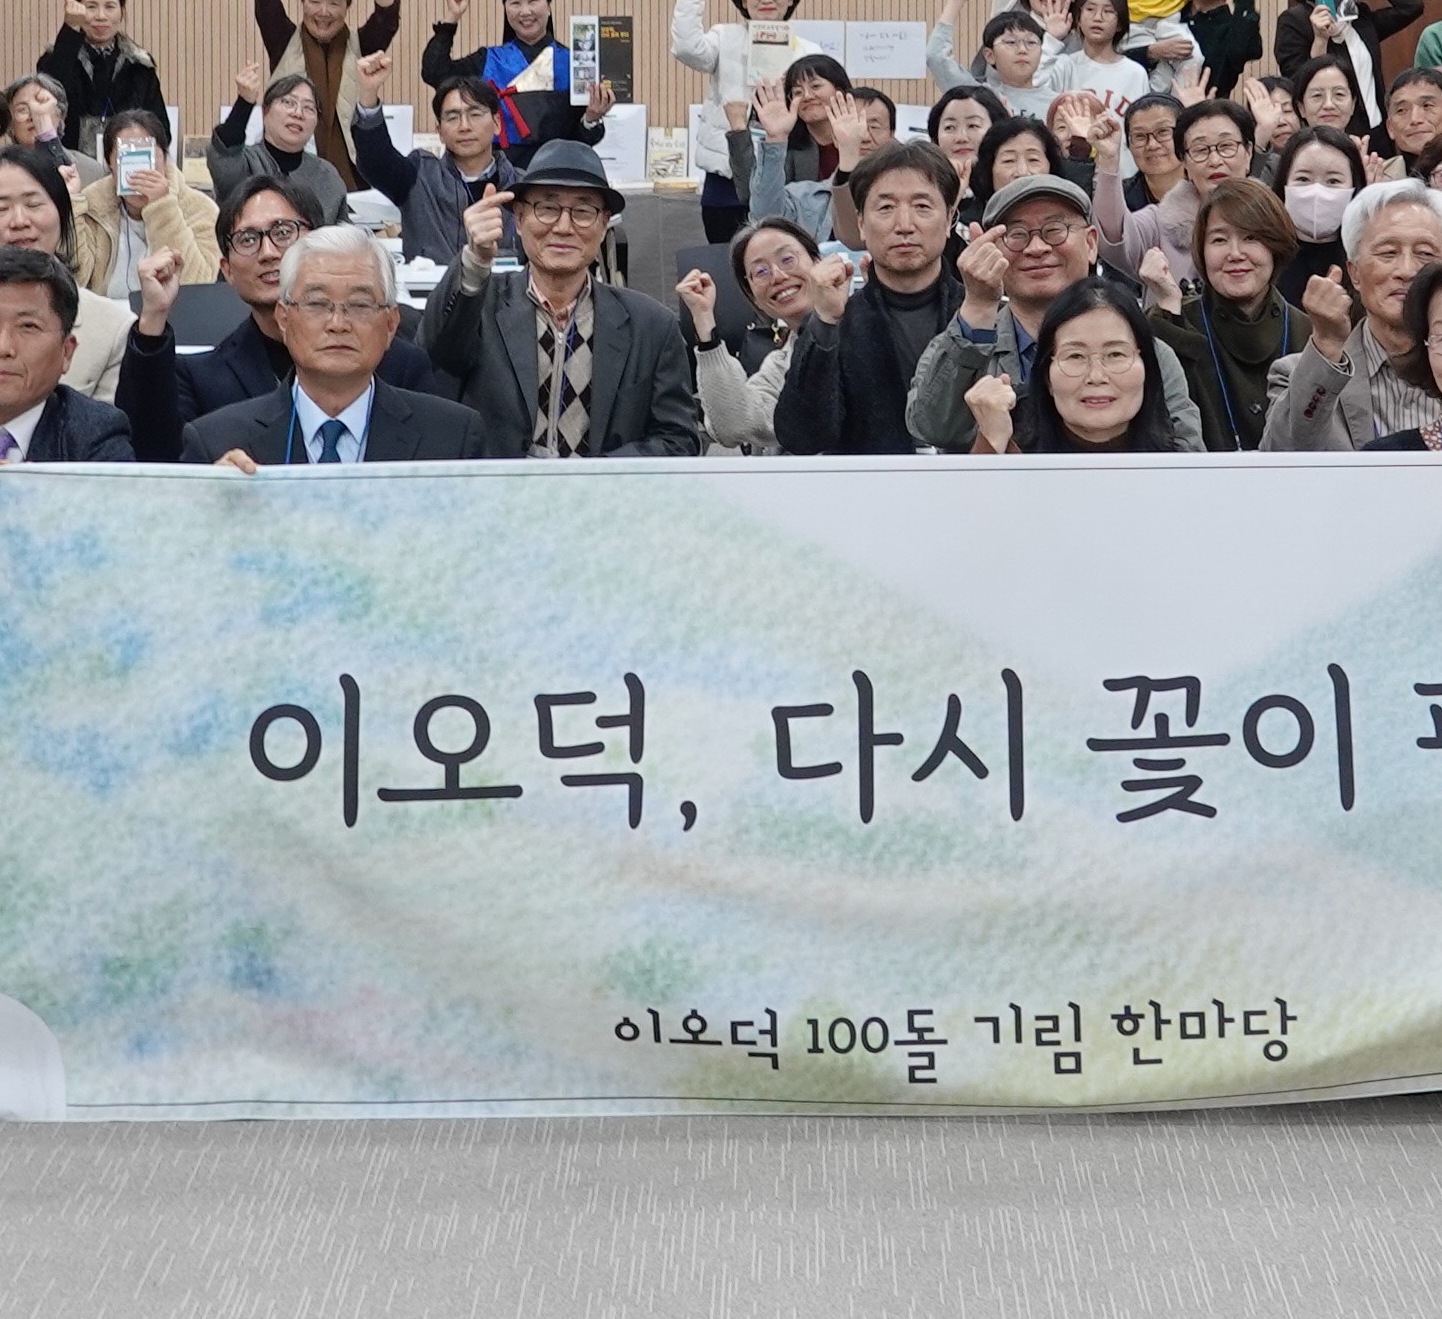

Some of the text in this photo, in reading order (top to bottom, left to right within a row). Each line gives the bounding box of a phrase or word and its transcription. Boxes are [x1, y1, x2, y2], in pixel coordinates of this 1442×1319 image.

[248, 671, 698, 832] 이오덕,
[770, 667, 1026, 825] 다시
[1085, 662, 1356, 824] 꽃이
[613, 996, 1299, 1085] 이오덕 100돌 기림 한마당
